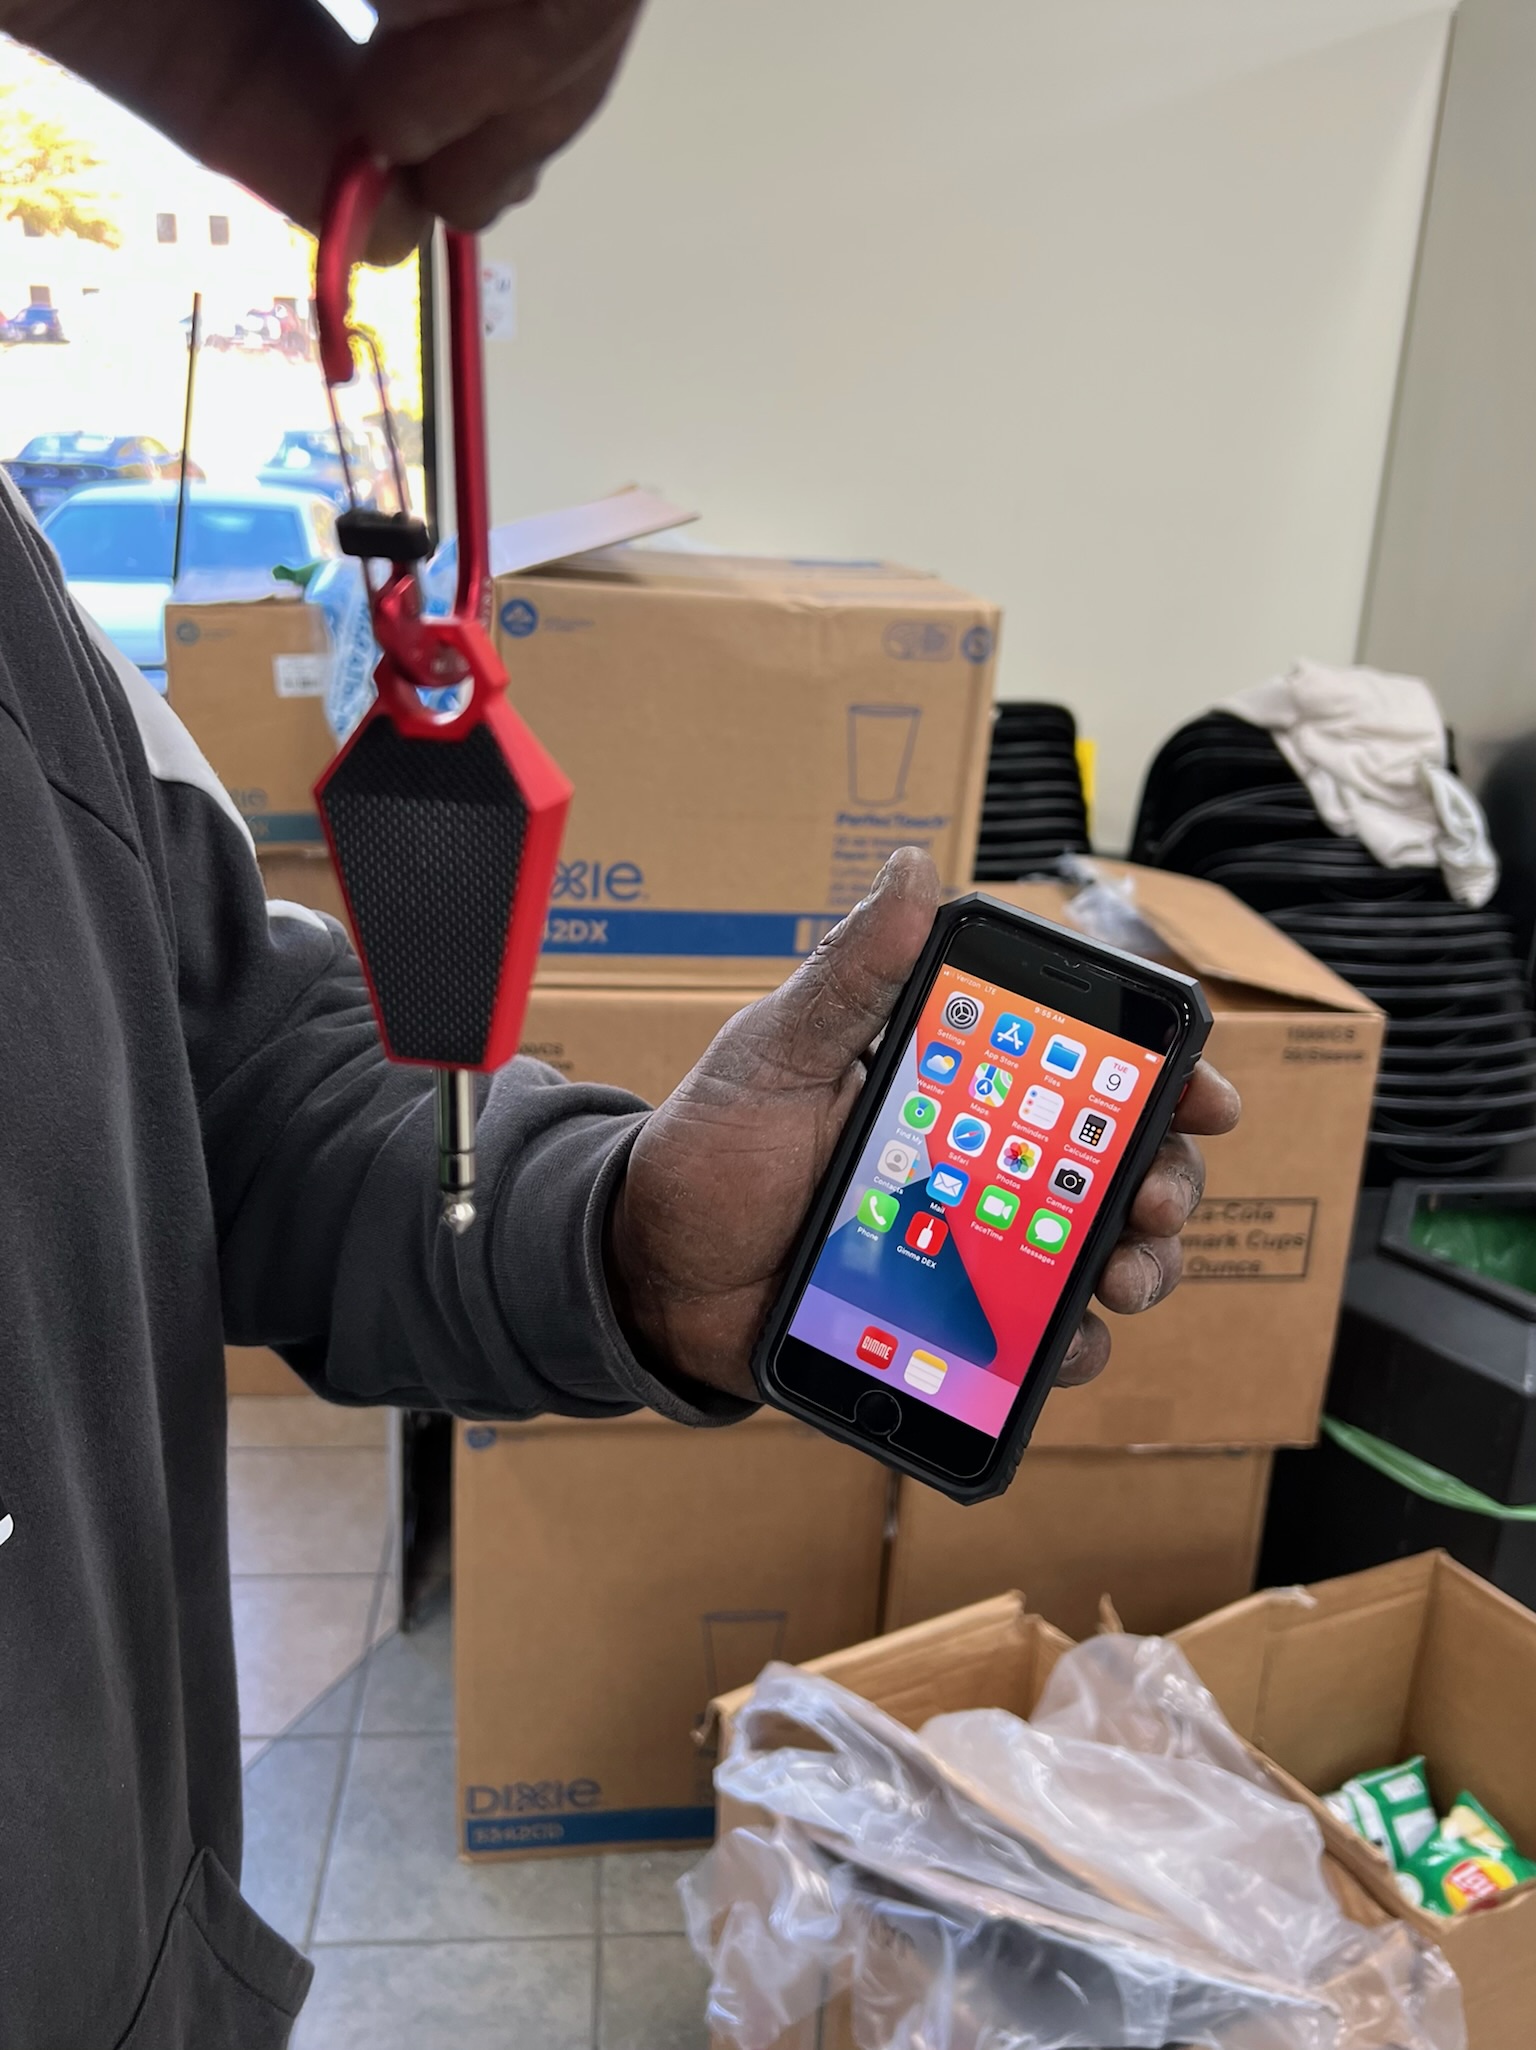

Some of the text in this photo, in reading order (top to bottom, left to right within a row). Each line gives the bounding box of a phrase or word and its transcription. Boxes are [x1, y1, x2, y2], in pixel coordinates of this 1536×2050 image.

[956, 972, 997, 995] Verizon LTE
[1034, 1007, 1065, 1024] 9:55 AM
[937, 1029, 966, 1046] Settings
[984, 1049, 1019, 1069] App Store
[1113, 1063, 1128, 1074] TUE
[917, 1078, 945, 1095] Weather
[1044, 1075, 1061, 1088] Files
[1106, 1073, 1121, 1091] 9
[970, 1102, 990, 1116] Maps
[1088, 1094, 1121, 1113] Calendar
[896, 1127, 923, 1145] Find My
[1011, 1120, 1049, 1143] Reminders
[948, 1151, 970, 1166] Safari
[1064, 1144, 1101, 1165] Calculator
[873, 1176, 904, 1195] Contacts
[996, 1173, 1021, 1190] Photos
[930, 1202, 946, 1215] Mail
[1046, 1196, 1074, 1214] Camera
[857, 1226, 879, 1241] Phone
[970, 1221, 1004, 1242] FaceTime
[896, 1245, 937, 1269] Gimme DEX
[1020, 1244, 1056, 1266] Messages
[861, 1335, 893, 1361] GIMME
